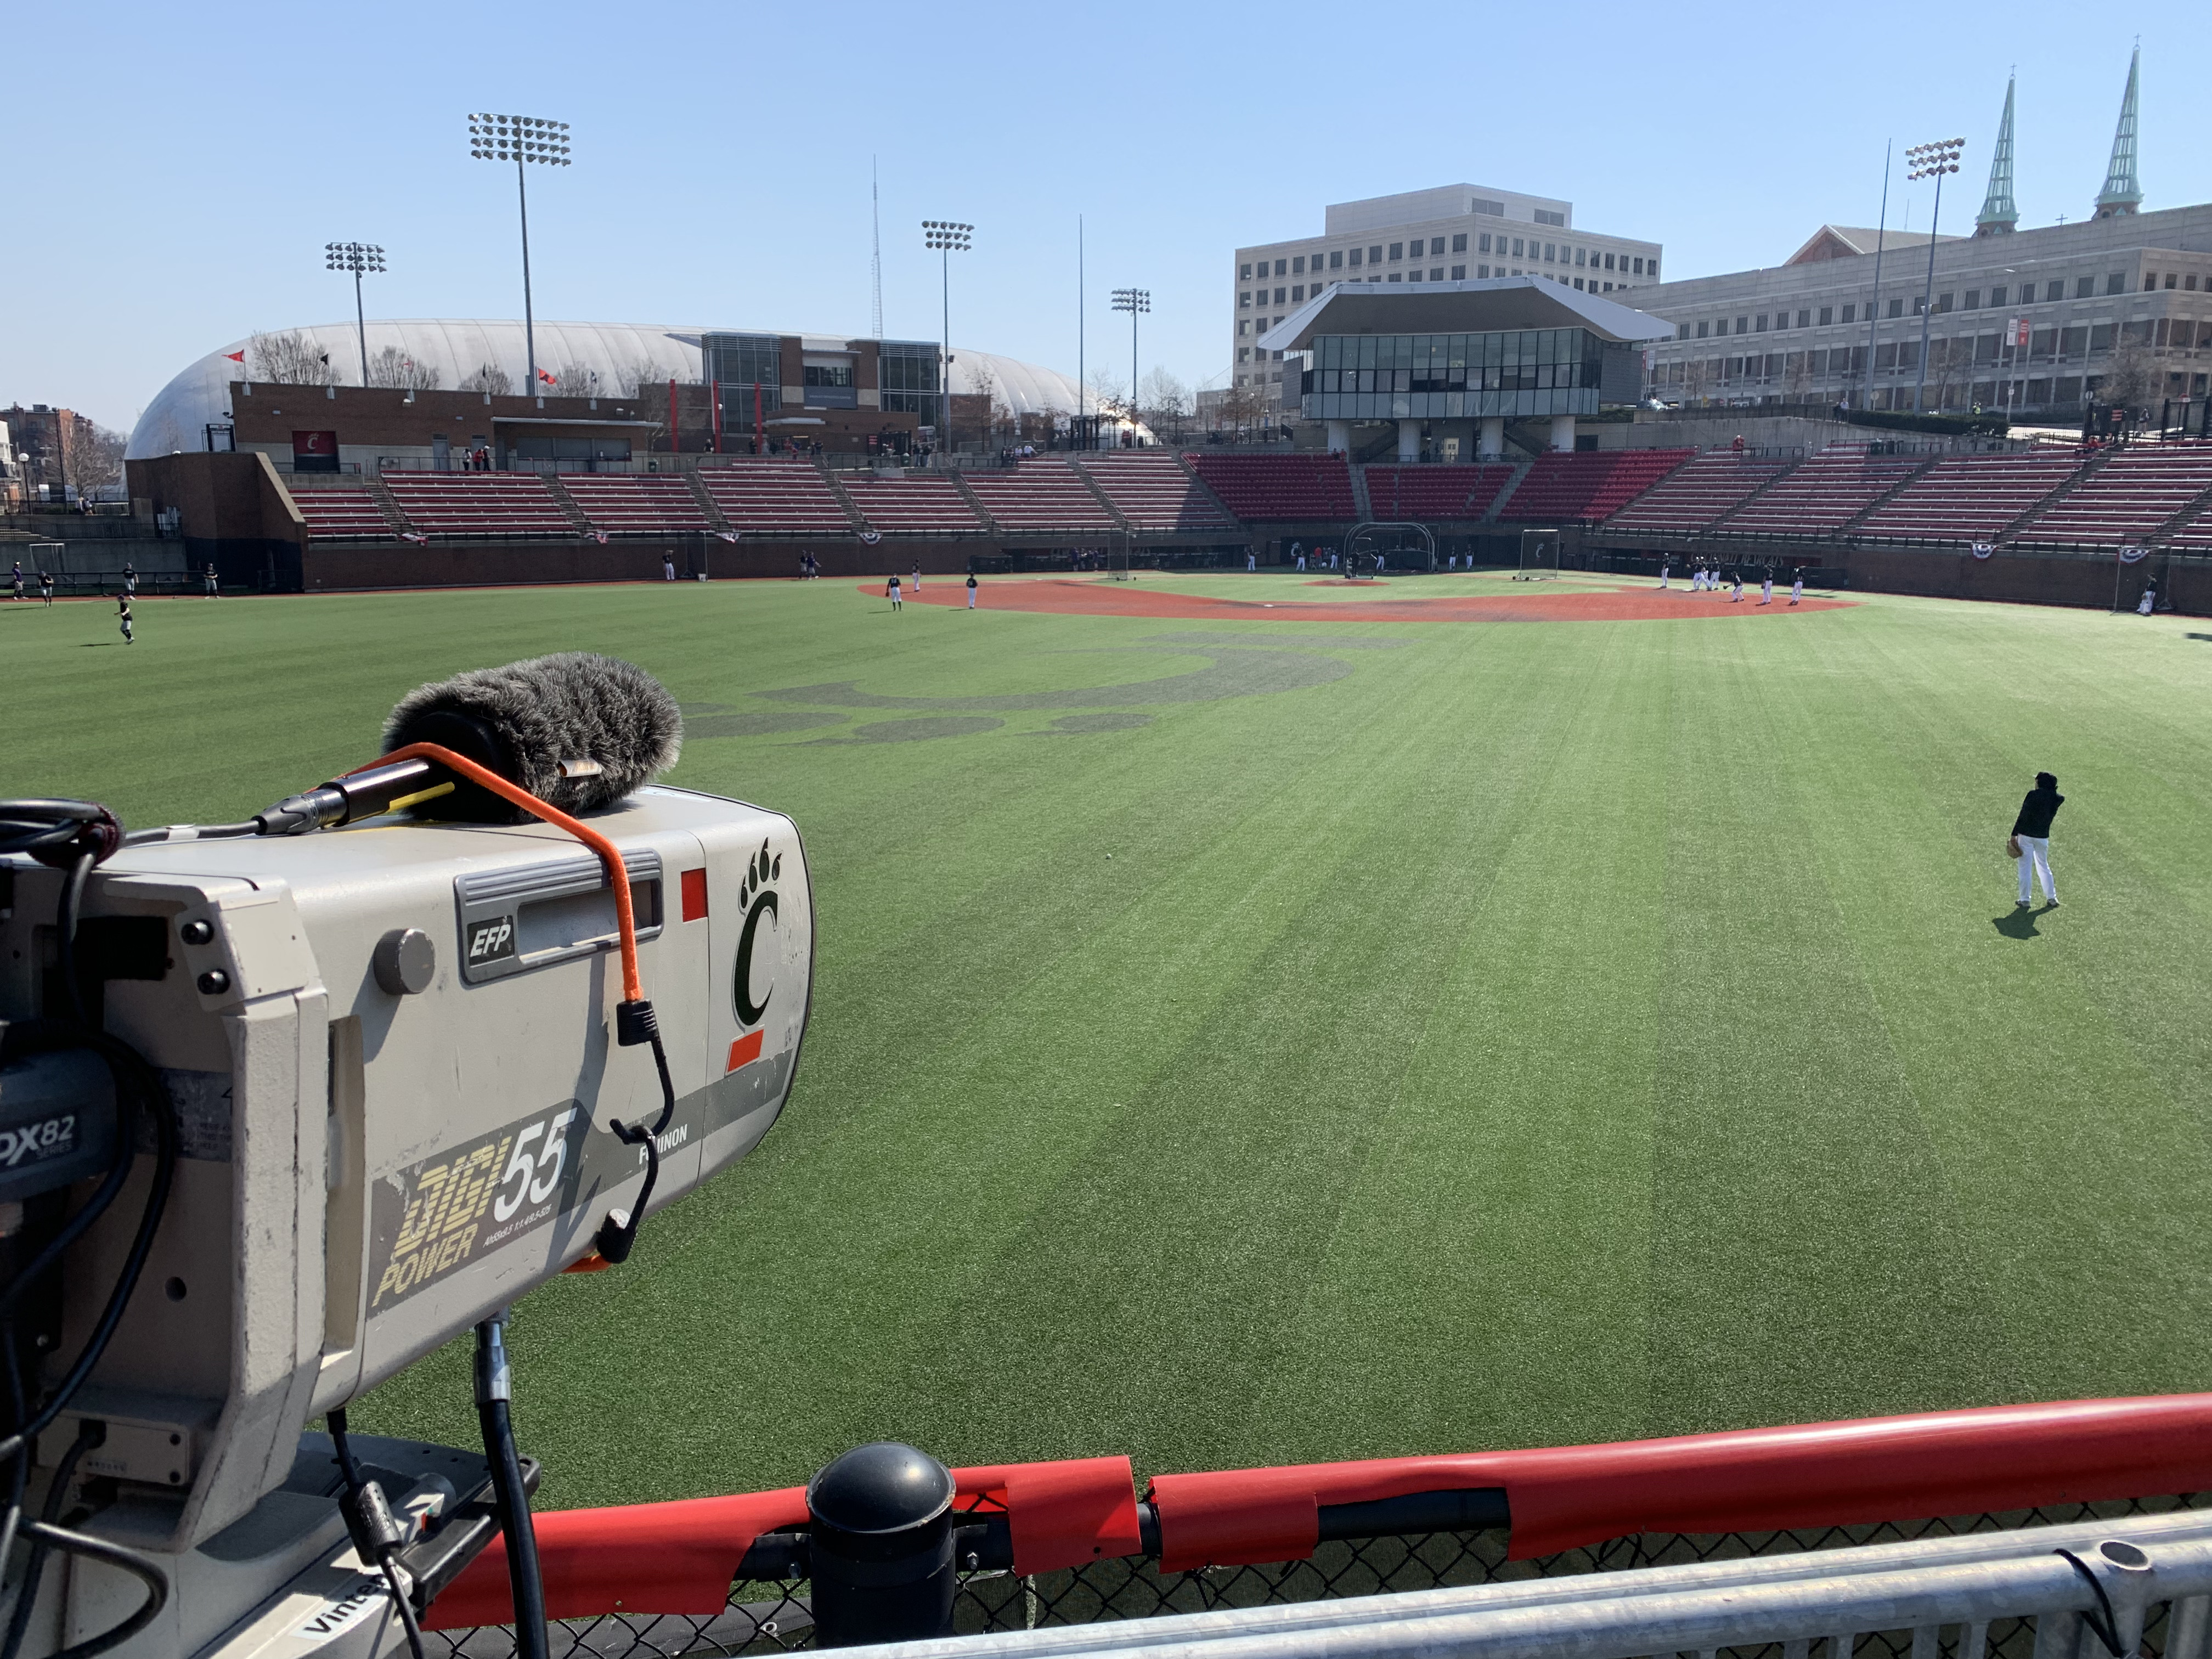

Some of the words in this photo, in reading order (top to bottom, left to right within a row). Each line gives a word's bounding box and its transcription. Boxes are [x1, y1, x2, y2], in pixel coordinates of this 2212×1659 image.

[469, 923, 511, 958] EFP
[35, 1141, 72, 1159] SERIES
[371, 1223, 478, 1307] POWER
[303, 1573, 386, 1633] Vinten
